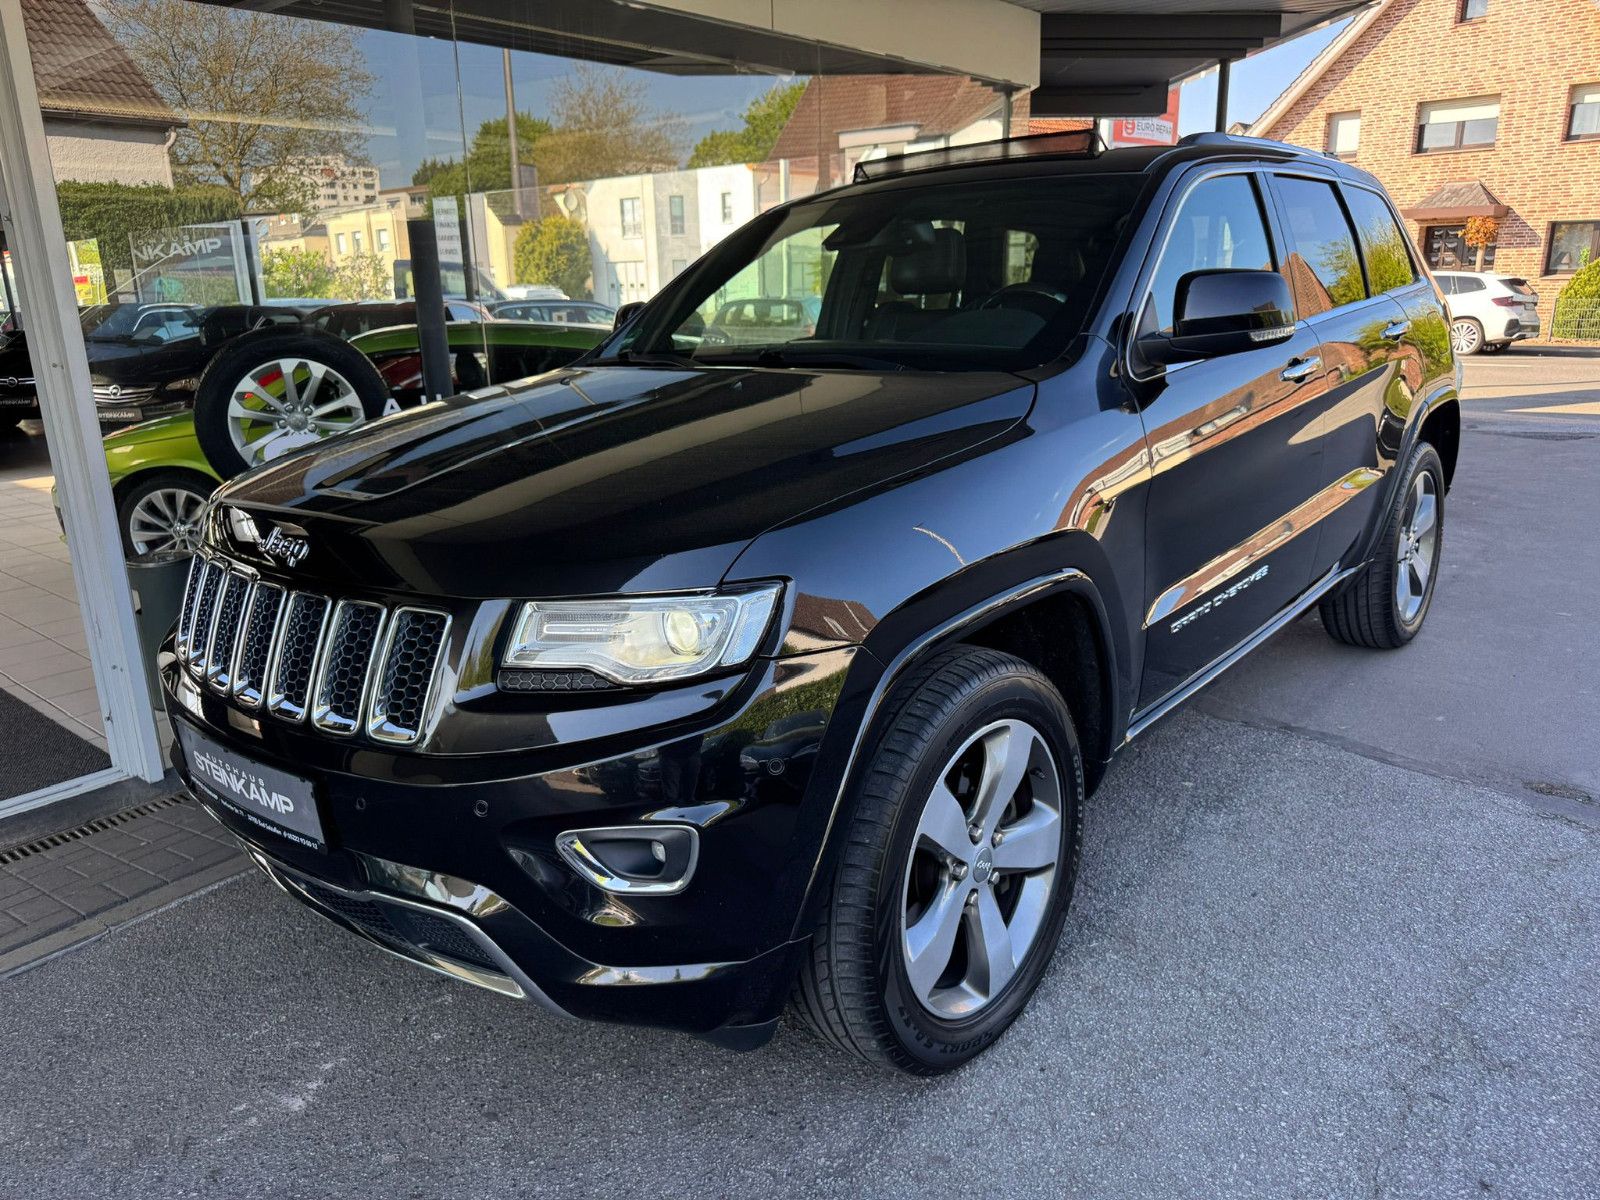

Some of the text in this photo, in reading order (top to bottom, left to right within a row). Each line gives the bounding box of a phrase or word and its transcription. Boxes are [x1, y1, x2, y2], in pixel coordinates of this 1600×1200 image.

[1136, 120, 1155, 132] EURO
[258, 526, 309, 568] Jeep
[193, 750, 294, 815] STEINKAMP
[206, 752, 265, 787] AUTOHAUS
